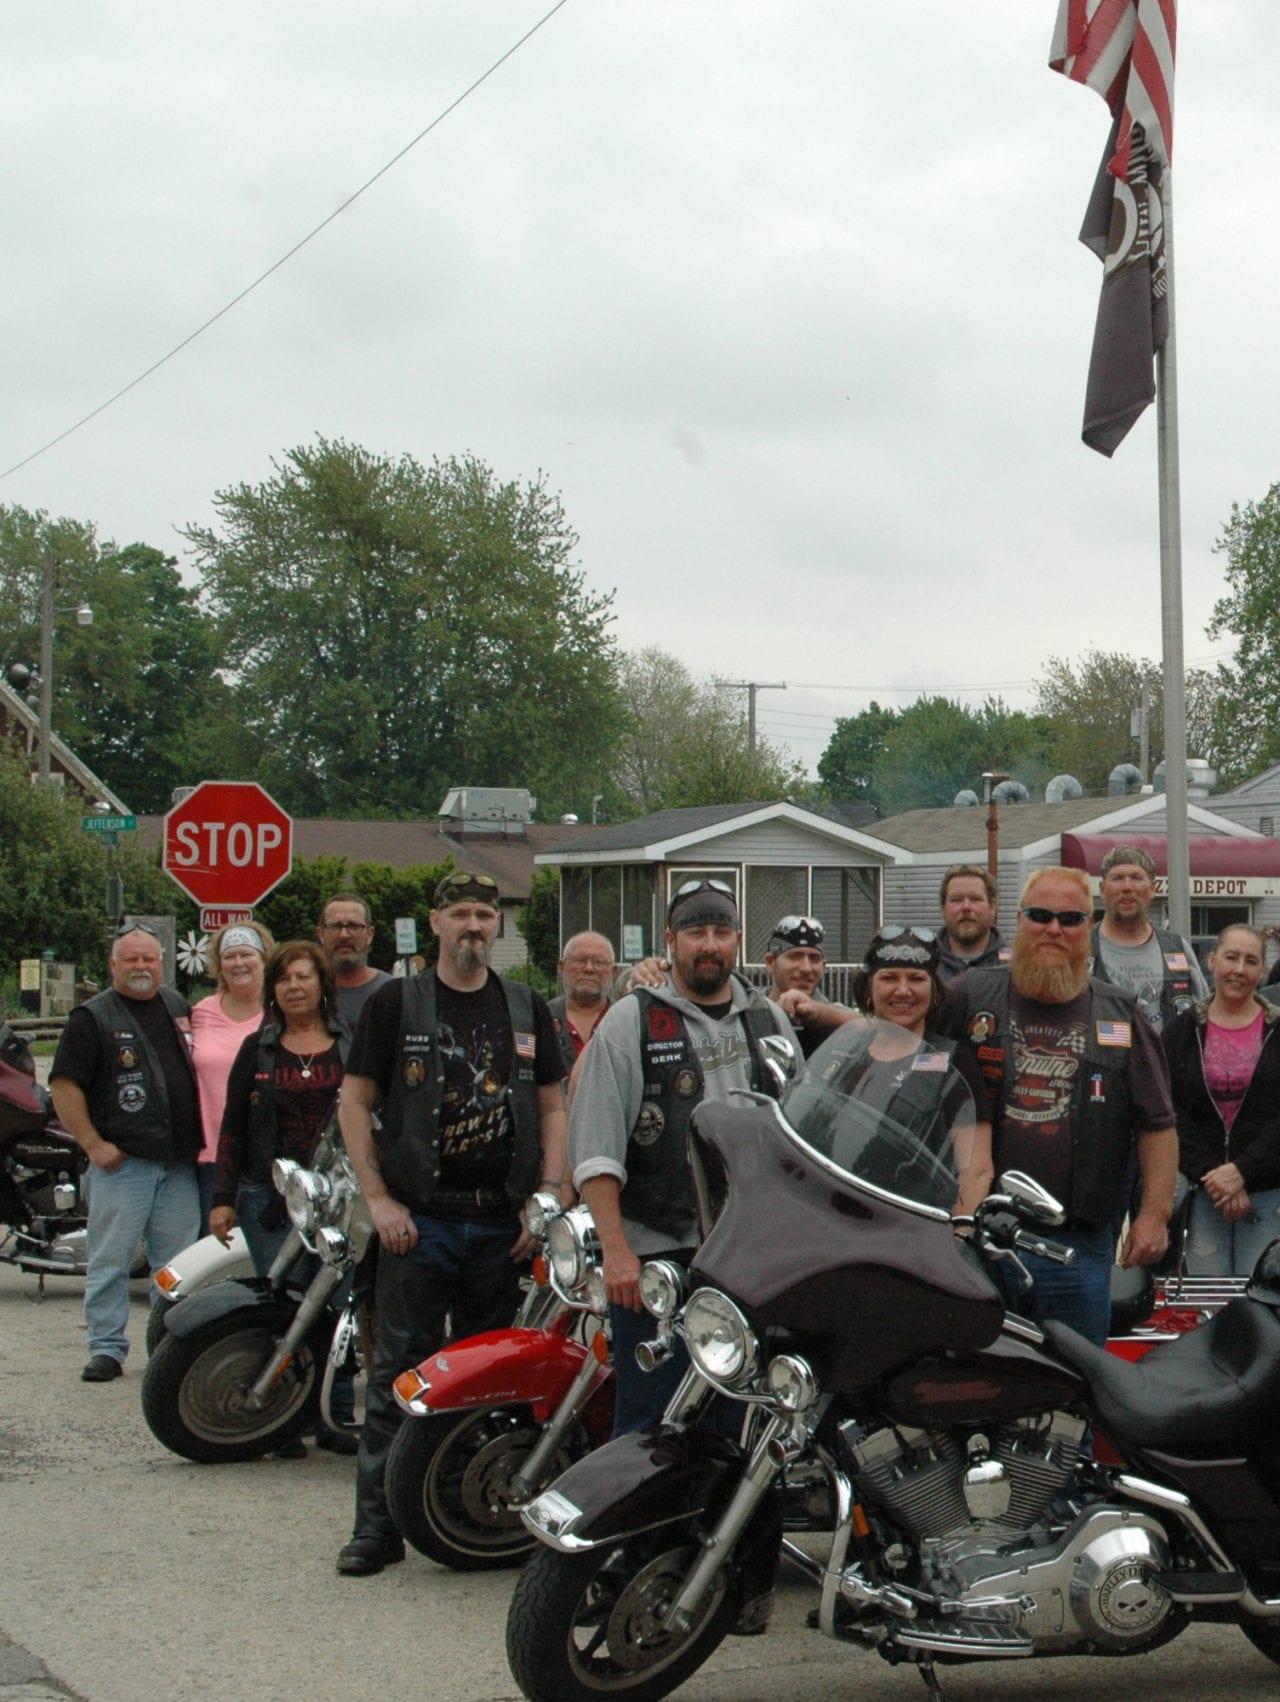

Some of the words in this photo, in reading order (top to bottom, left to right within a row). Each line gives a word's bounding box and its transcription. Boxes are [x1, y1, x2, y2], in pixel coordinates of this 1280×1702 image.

[85, 818, 126, 830] JEFFERSON
[174, 821, 282, 867] STOP
[1193, 880, 1247, 894] DEPOT
[204, 913, 223, 927] ALL
[227, 913, 250, 927] WAY
[647, 1041, 684, 1051] DIRECTOR
